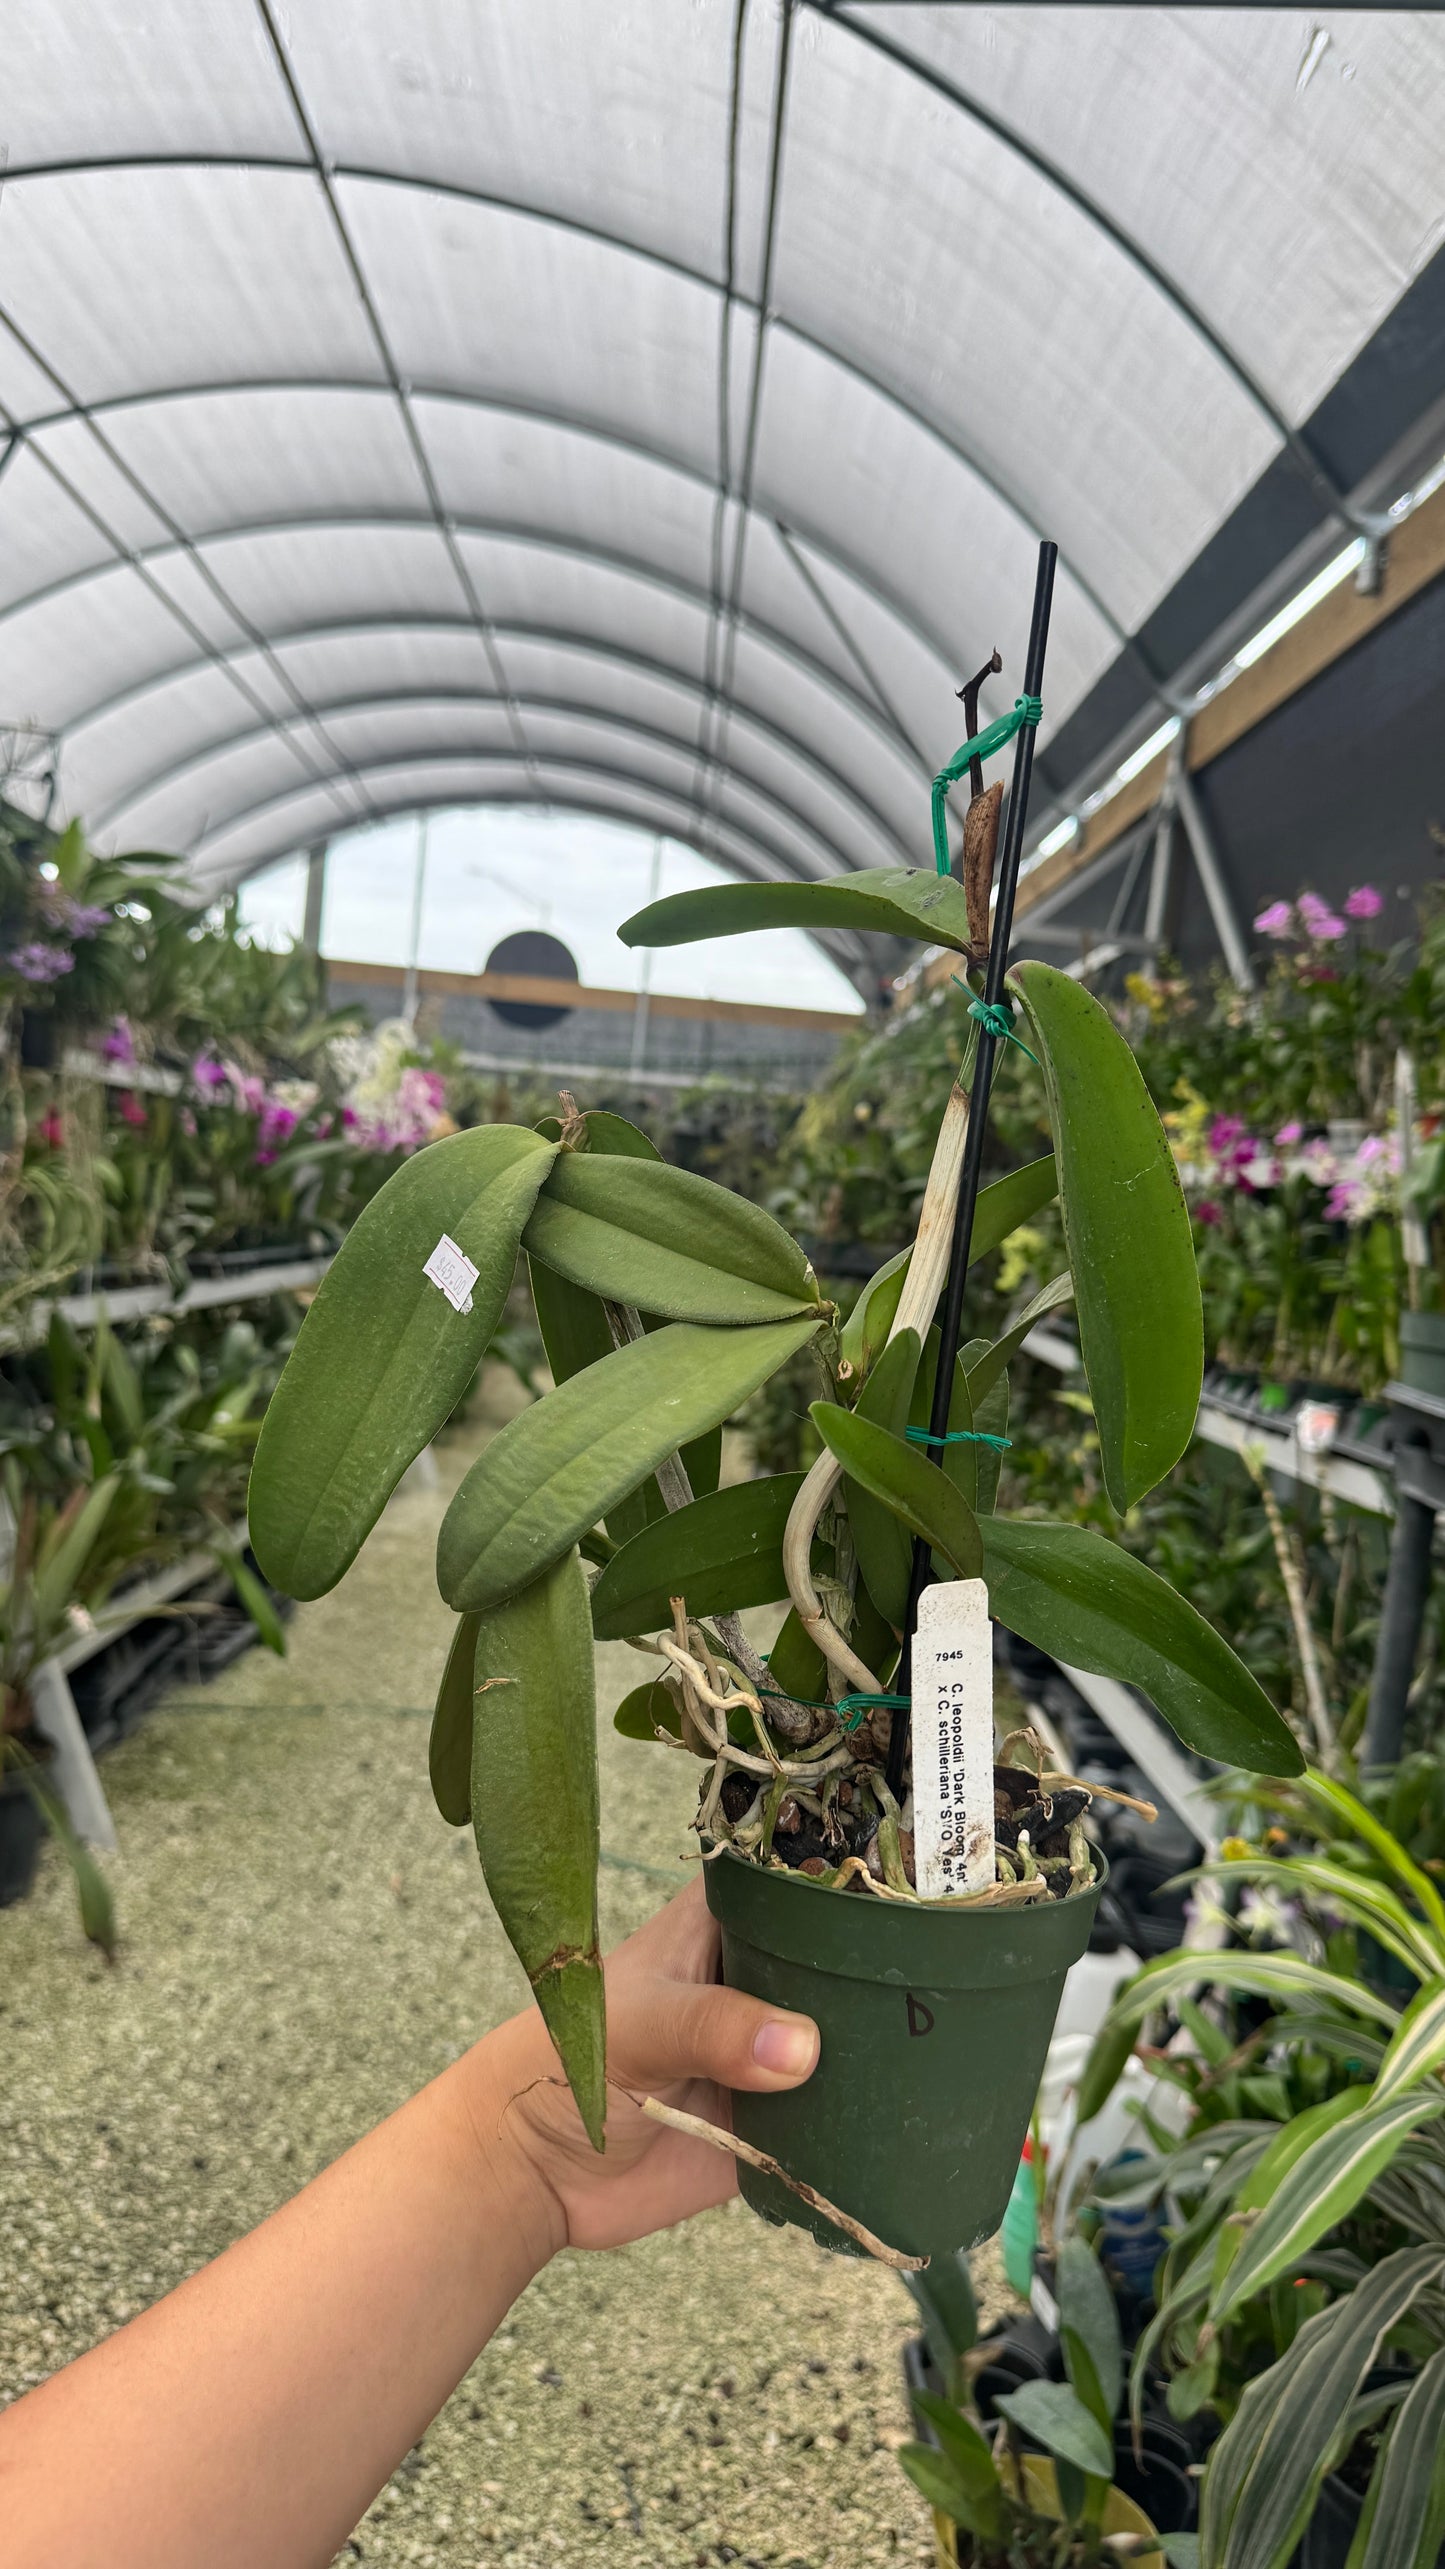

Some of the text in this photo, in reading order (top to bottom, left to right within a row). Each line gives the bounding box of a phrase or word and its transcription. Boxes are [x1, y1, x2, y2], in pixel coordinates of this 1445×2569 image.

[436, 1256, 467, 1296] $45.00
[936, 1650, 963, 1662] 7945
[938, 1700, 950, 1714] C.
[951, 1683, 964, 1698] C.
[951, 1703, 965, 1763] leopoldii
[939, 1720, 951, 1800] schilleriana
[953, 1768, 966, 1805] 'Dark
[955, 1811, 966, 1857] Bloom
[906, 1992, 935, 2037] D
